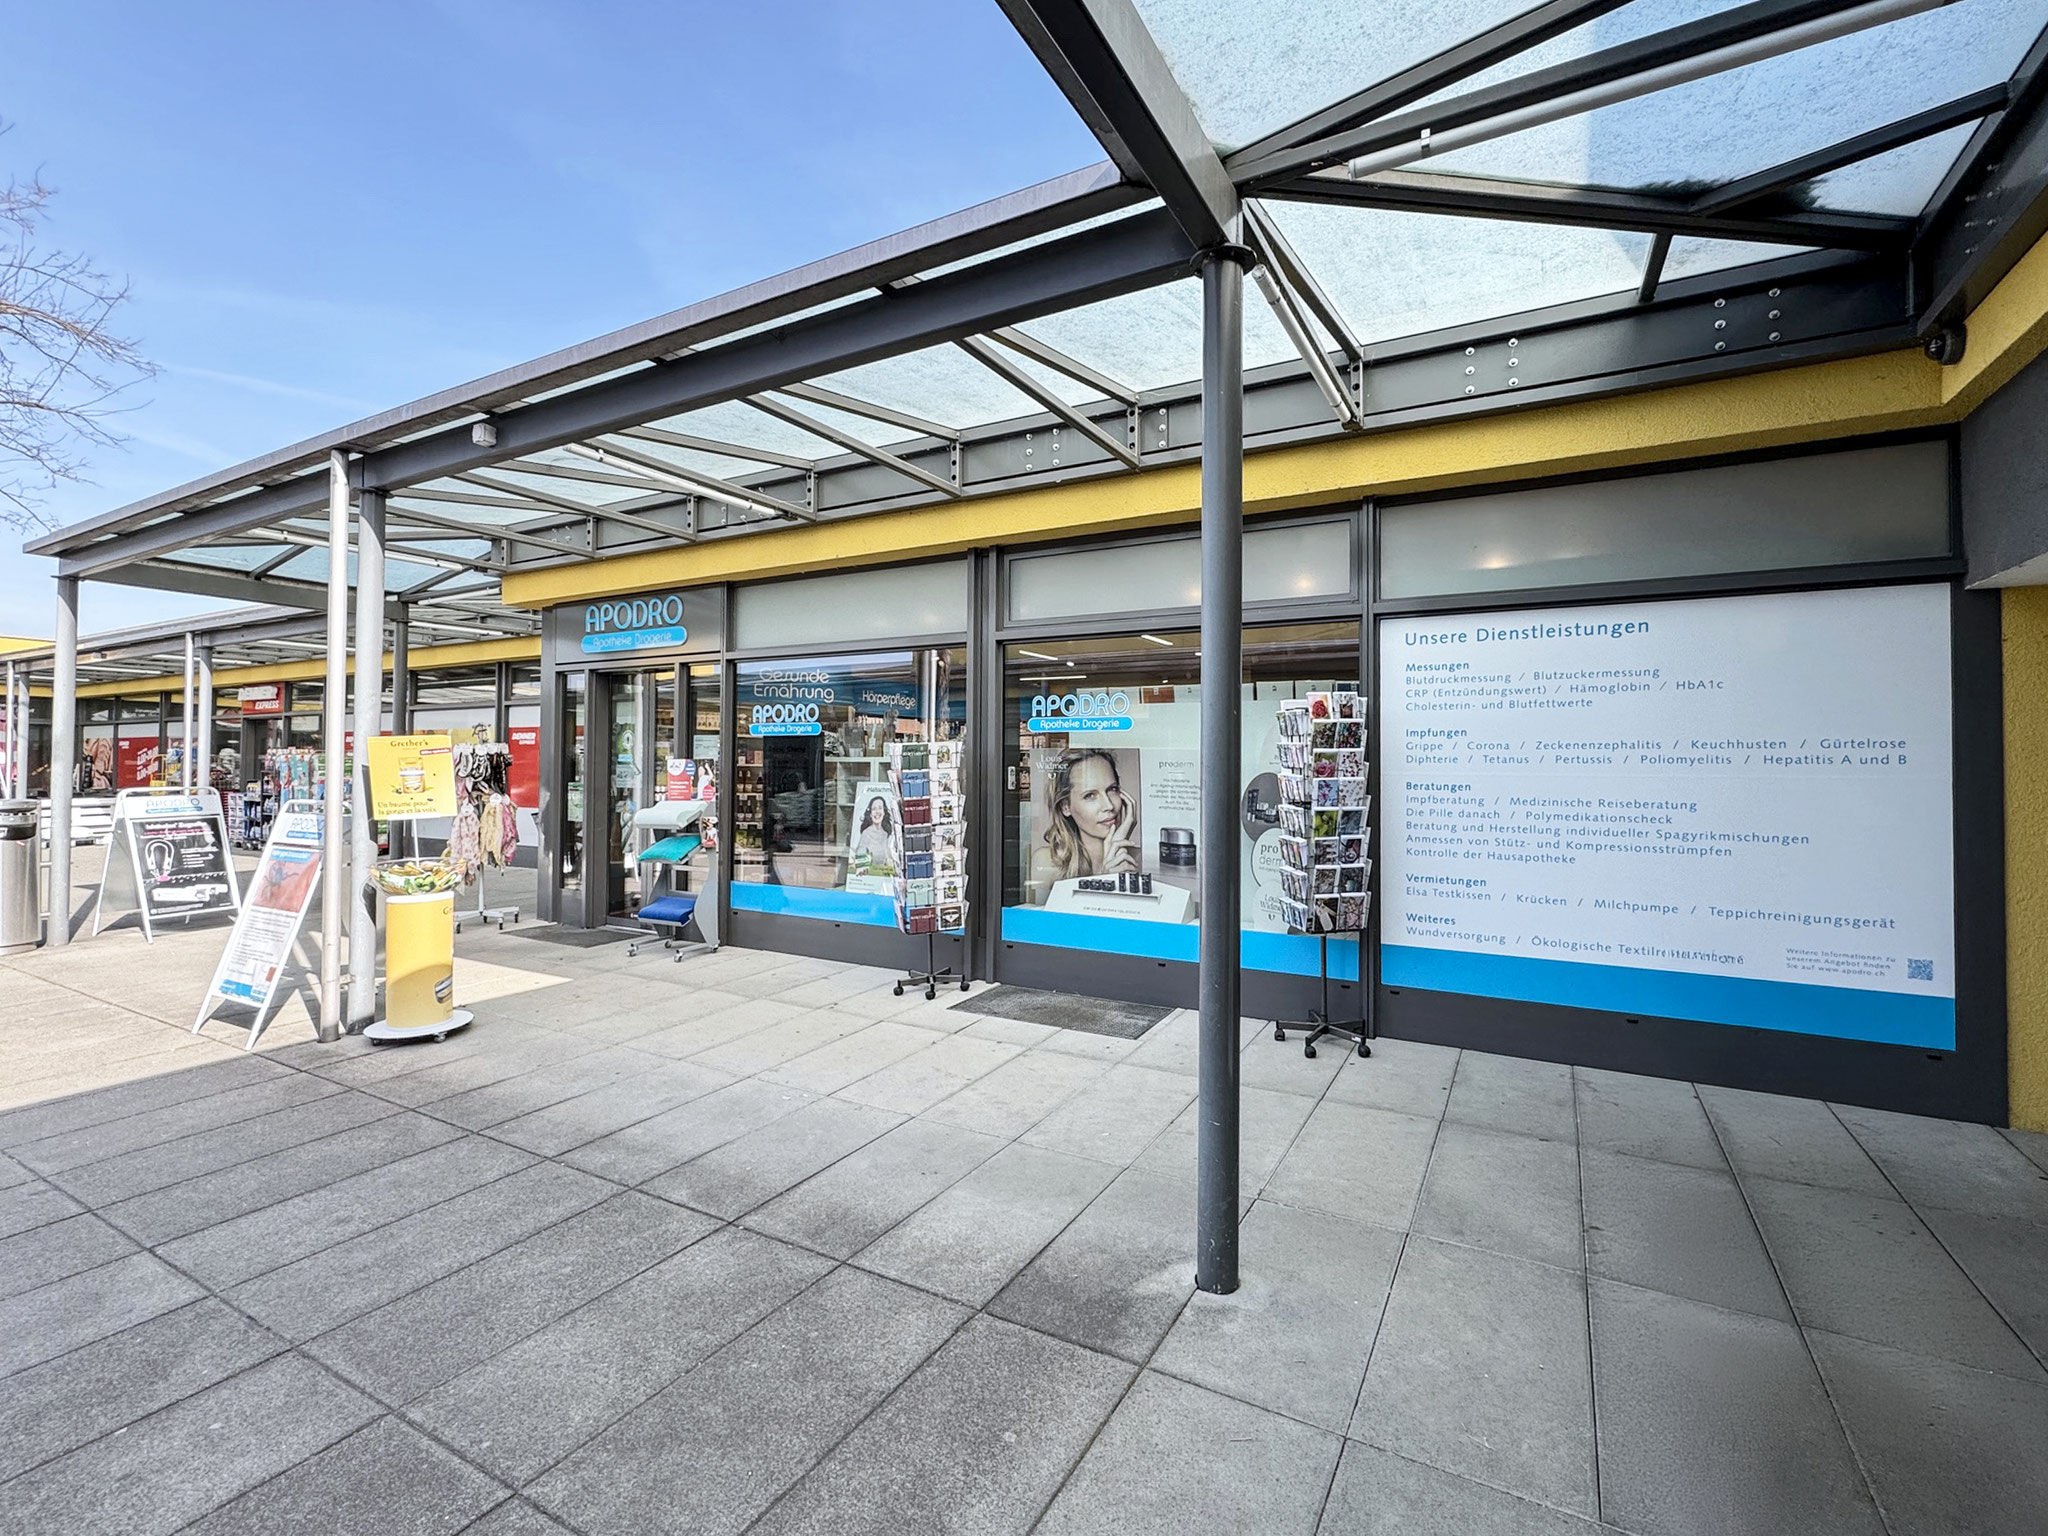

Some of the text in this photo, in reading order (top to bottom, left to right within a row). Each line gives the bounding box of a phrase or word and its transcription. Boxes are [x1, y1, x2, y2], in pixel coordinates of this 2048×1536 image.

[585, 595, 683, 633] APODRO
[593, 631, 673, 648] Apotheke Drogerie
[1404, 621, 1649, 646] Unsere Dienstleistungen
[759, 667, 829, 684] Gesunde
[1405, 662, 1470, 673] Messungen
[1405, 674, 1512, 685] Blutdruckmessung
[1533, 668, 1660, 681] Blutzuckermessung
[753, 683, 835, 703] Ernährung
[1405, 688, 1429, 698] CRP
[1432, 684, 1547, 698] (Entzündungswert)
[1569, 681, 1651, 695] Hämoglobin
[1676, 679, 1724, 690] HbA1c
[255, 700, 279, 710] EXPRESS
[752, 703, 820, 723] APODRO
[1032, 692, 1130, 717] APODRO
[1405, 698, 1593, 712] Cholesterin- und Blutfettwerte
[757, 724, 813, 735] Apotheke Drogerie
[1040, 719, 1120, 731] Apotheke Drogerie
[1405, 727, 1468, 740] Impfungen
[390, 739, 429, 747] Grether's
[1405, 741, 1444, 753] Grippe
[1466, 740, 1510, 751] Corona
[1535, 739, 1662, 753] Zeckenenzephalitis
[1691, 738, 1787, 750] Keuchhusten
[1819, 737, 1907, 749] Gürtelrose
[1035, 762, 1069, 771] Widmer
[1158, 761, 1195, 769] proderm
[1406, 754, 1459, 766] Diphterie
[1482, 754, 1530, 764] Tetanus
[1555, 754, 1613, 765] Pertussis
[1640, 753, 1732, 767] Poliomyelitis
[1763, 754, 1834, 768] Hepatitis
[1840, 754, 1853, 765] A
[1859, 753, 1890, 765] und
[1898, 754, 1907, 765] B
[1405, 781, 1472, 794] Beratungen
[1406, 794, 1485, 808] Impfberatung
[1509, 796, 1593, 808] Medizinische
[1598, 798, 1698, 813] Reiseberatung
[1405, 807, 1425, 817] Die
[1429, 808, 1454, 818] Pille
[1457, 808, 1501, 819] danach
[1525, 810, 1673, 825] Polymedikationscheck
[1406, 820, 1809, 847] Beratung und Herstellung individueller Spagyrikmischungen
[1260, 844, 1279, 855] pro
[1405, 834, 1732, 858] Anmessen von Stütz- und Kompressionsstrümpfen
[1406, 847, 1576, 864] Kontrolle der Hausapotheke
[1405, 873, 1487, 889] Vermietungen
[1406, 886, 1428, 897] Elsa
[1431, 887, 1491, 901] Testkissen
[1516, 893, 1567, 906] Krücken
[1593, 898, 1679, 916] Milchpumpe
[1708, 906, 1896, 930] Teppichreinigungsgerät
[1405, 912, 1456, 926] Weiteres
[1405, 926, 1506, 946] Wundversorgung
[1531, 935, 1612, 953] Ökologische
